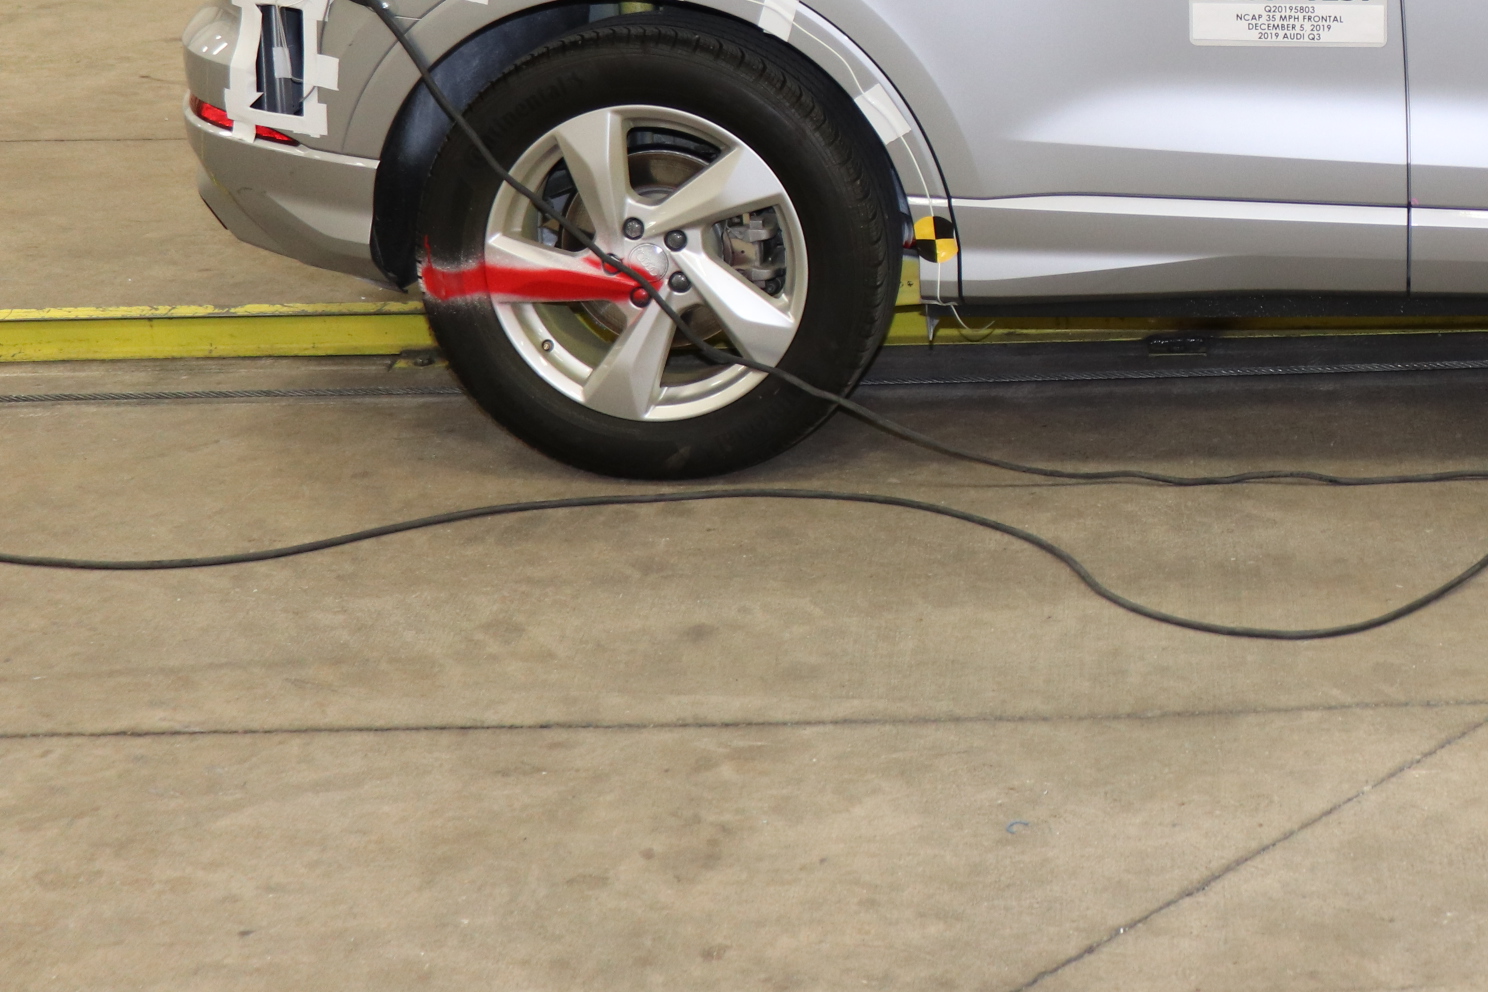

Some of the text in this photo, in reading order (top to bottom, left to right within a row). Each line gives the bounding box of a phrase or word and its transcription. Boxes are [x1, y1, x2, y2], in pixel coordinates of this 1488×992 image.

[1264, 5, 1316, 14] Q20195803
[1236, 14, 1344, 24] NCAP 35 MPH FRONTAL
[1248, 23, 1297, 32] DECEMBER
[1310, 24, 1332, 32] 2019
[1258, 32, 1322, 42] 2019 AUDI Q3
